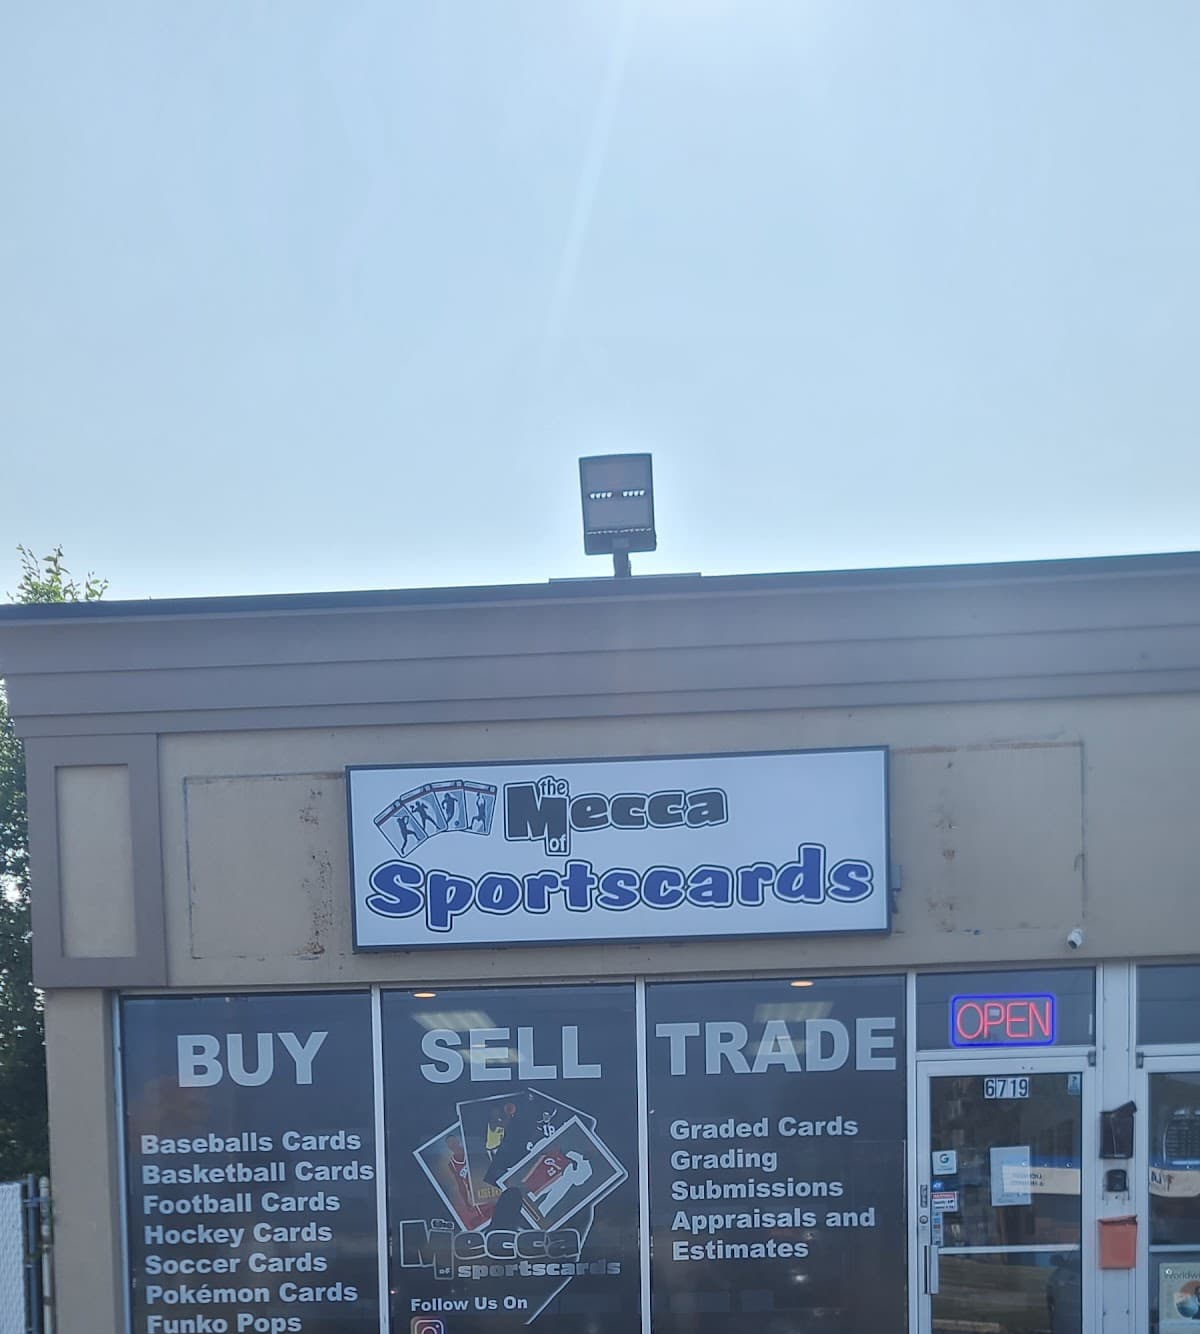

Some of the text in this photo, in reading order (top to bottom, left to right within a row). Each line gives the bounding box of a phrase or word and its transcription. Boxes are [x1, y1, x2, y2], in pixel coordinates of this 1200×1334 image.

[540, 779, 568, 796] the
[504, 782, 728, 856] Mecca
[550, 834, 567, 851] of
[367, 844, 873, 932] Sportscards
[956, 1001, 1050, 1040] OPEN
[420, 1026, 601, 1083] SELL
[656, 1017, 896, 1075] TRADE
[177, 1031, 329, 1088] BUY
[984, 1078, 1029, 1097] 6719
[670, 1115, 858, 1140] Graded Cards
[140, 1130, 361, 1155] Baseballs Cards
[142, 1160, 375, 1185] Basketball Cards
[670, 1148, 778, 1173] Grading
[671, 1177, 844, 1201] Submissions
[143, 1191, 341, 1215] Football Cards
[672, 1207, 875, 1234] Appraisals and
[144, 1222, 333, 1248] Hockey Cards
[400, 1219, 581, 1279] Mecca
[673, 1239, 809, 1261] Estimates
[145, 1252, 328, 1275] Soccer Cards
[458, 1259, 621, 1279] sportscards
[146, 1281, 358, 1305] Pokémon Cards
[411, 1295, 528, 1312] Follow Us On
[147, 1314, 228, 1334] Funko
